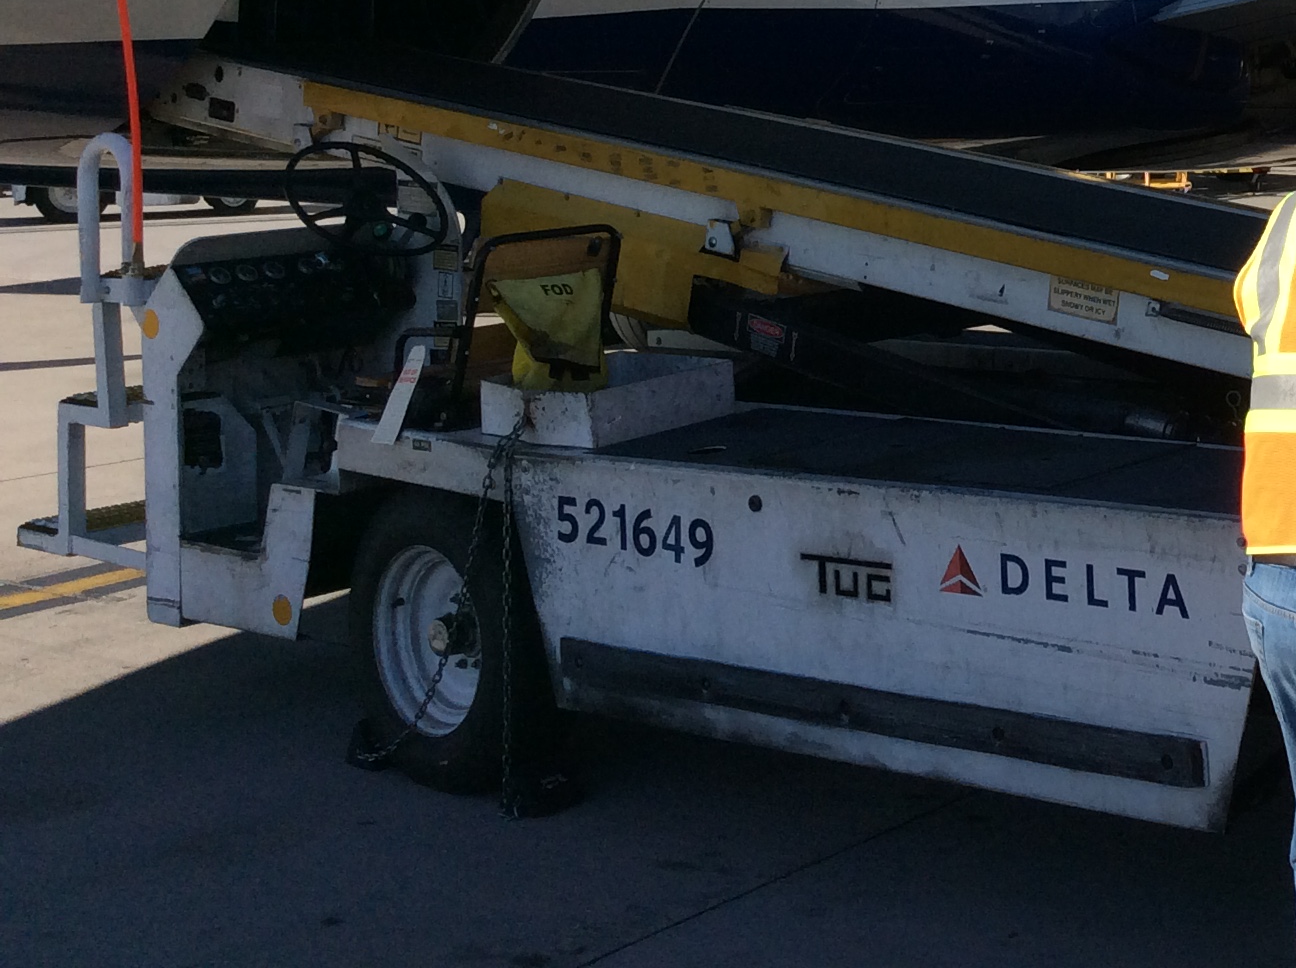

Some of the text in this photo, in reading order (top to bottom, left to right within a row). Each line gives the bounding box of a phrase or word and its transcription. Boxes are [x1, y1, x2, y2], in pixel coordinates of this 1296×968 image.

[540, 283, 574, 296] FOD
[556, 494, 715, 568] 521649
[1001, 552, 1190, 620] DELTA
